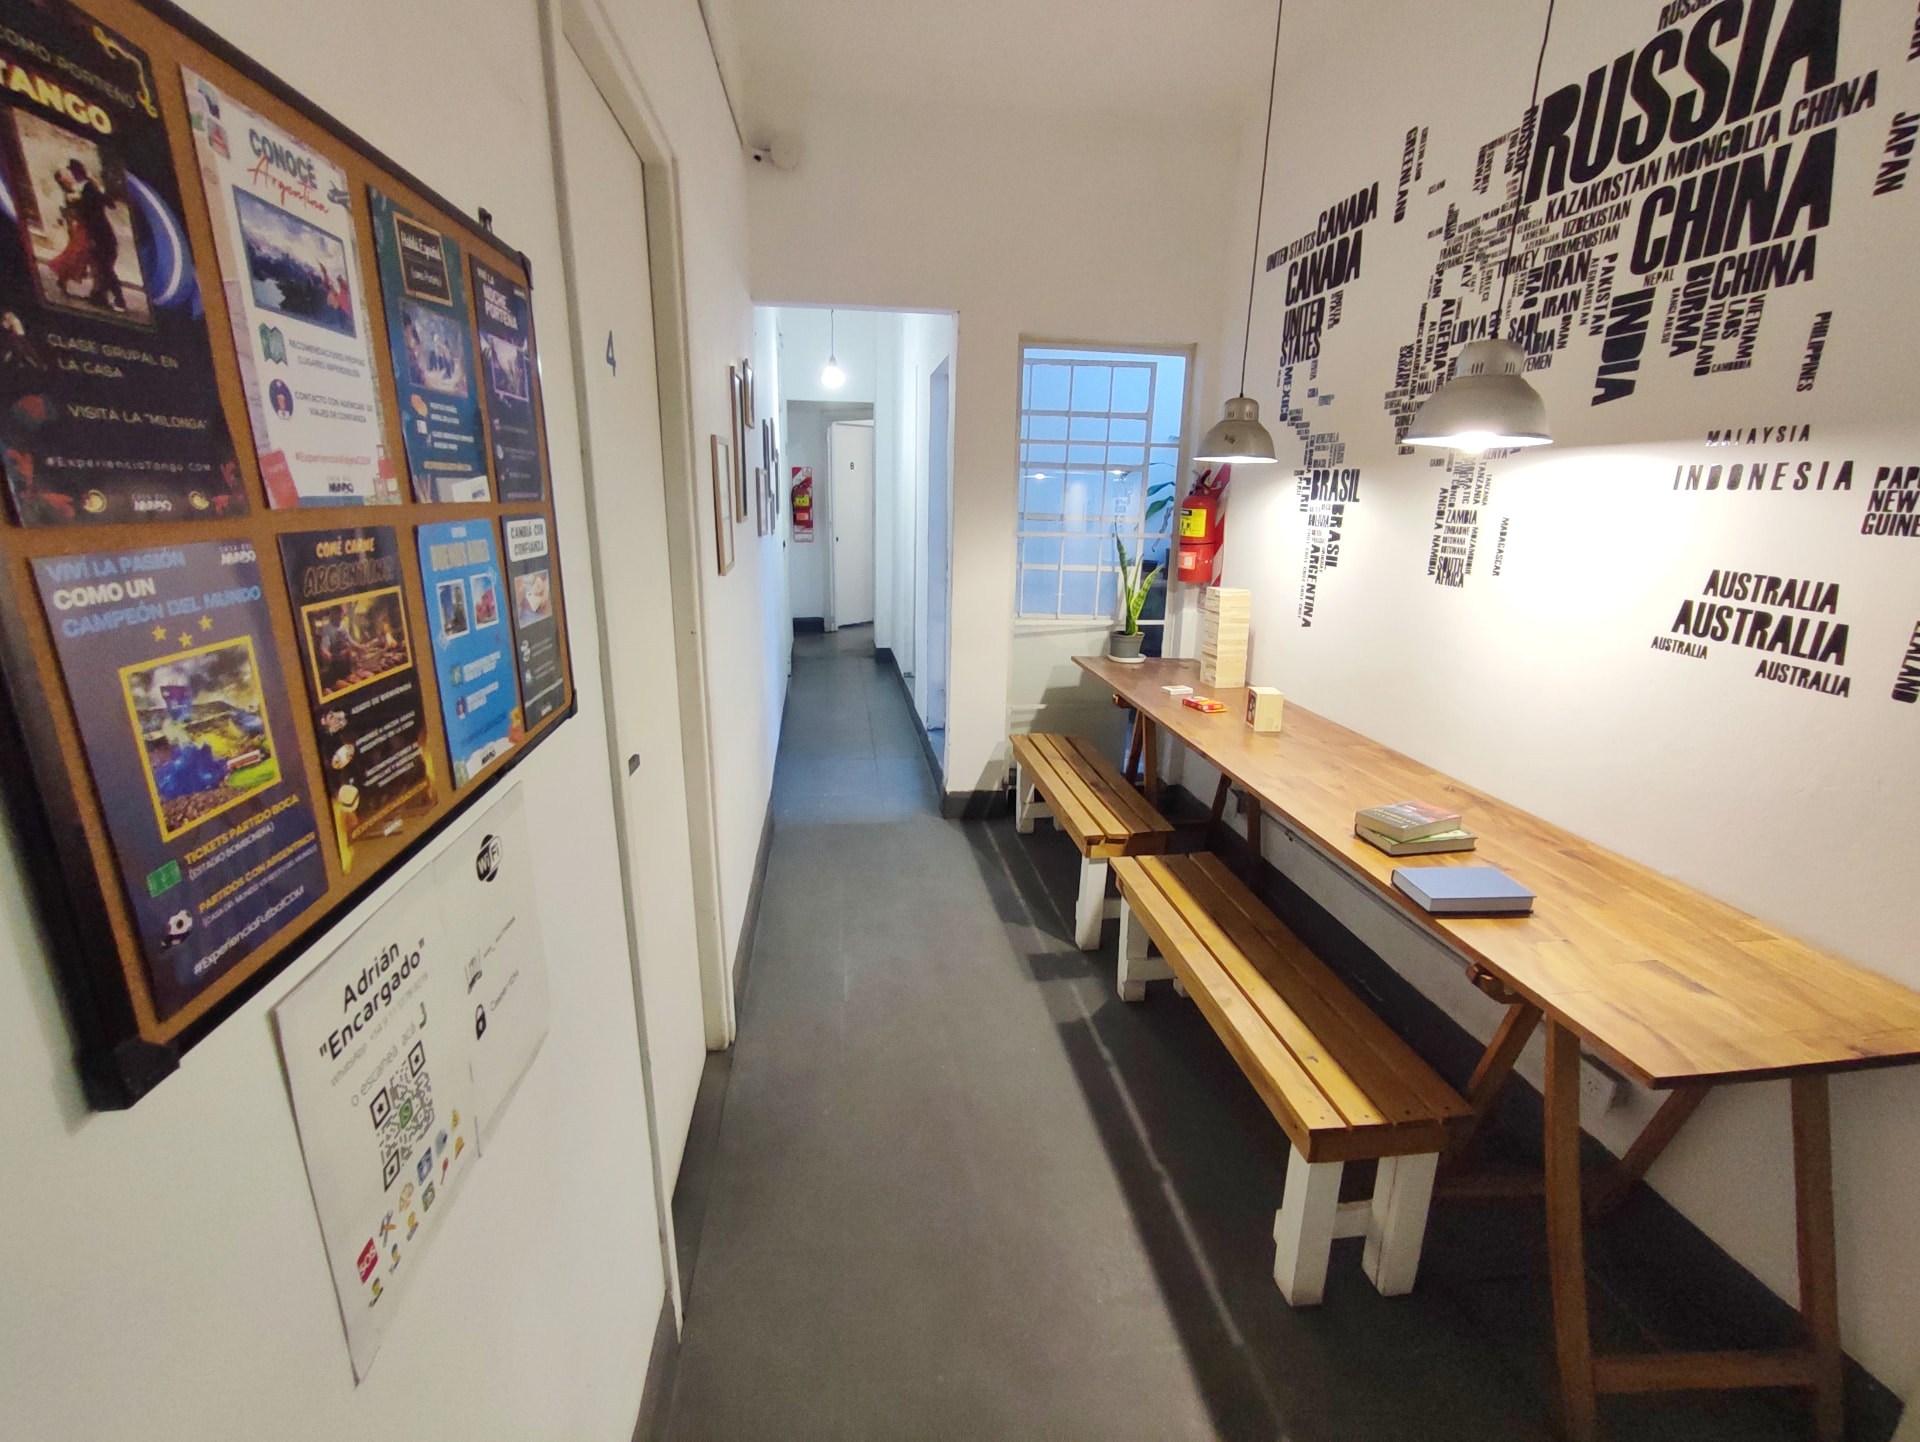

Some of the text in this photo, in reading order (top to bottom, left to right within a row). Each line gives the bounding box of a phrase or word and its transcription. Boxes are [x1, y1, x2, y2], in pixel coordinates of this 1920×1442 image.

[0, 25, 51, 62] OMO
[1523, 0, 1842, 206] RUSSIA
[1787, 69, 1879, 137] CHINA
[1663, 109, 1782, 184] MONGOLIA
[1394, 126, 1419, 224] GREENLAND
[1545, 155, 1663, 226] KAZAKHSTAN
[1316, 181, 1379, 248] CANADA
[1561, 198, 1633, 239] UZBEKISTAN
[1630, 127, 1838, 276] CHINA
[1288, 231, 1317, 262] STATES
[1496, 247, 1541, 280] TURKEY
[1543, 223, 1621, 263] TURKMENISTAN
[1285, 229, 1364, 307] CANADA
[1541, 248, 1593, 294] IRAN
[1643, 269, 1675, 288] NEPAL
[1711, 234, 1818, 301] CHINA
[1542, 289, 1582, 320] IRAN
[1578, 257, 1601, 327] AFGHANISTAN
[1588, 251, 1619, 337] PAKISTAN
[1668, 260, 1716, 359] BURMA
[1279, 328, 1322, 368] STATES
[1423, 320, 1438, 365] ALGERIA
[1432, 298, 1457, 373] ALGERIA
[1556, 313, 1574, 350] OMAN
[1591, 287, 1656, 408] INDIA
[1693, 300, 1726, 377] THAILAND
[1736, 293, 1767, 361] VIETNAM
[57, 358, 80, 371] LA
[605, 330, 617, 377] 4
[1796, 310, 1833, 393] PHILIPPINES
[66, 403, 120, 421] VISITA
[1279, 366, 1295, 422] MEXICO
[1706, 423, 1811, 447] MALAYSIA
[1310, 468, 1361, 503] BRASIL
[1472, 461, 1487, 505] TANZANIA
[1673, 460, 1854, 491] INDONESIA
[1873, 465, 1920, 490] PAP
[1433, 487, 1449, 531] ANGOLA
[1445, 509, 1478, 526] ZAMBIA
[1866, 490, 1918, 514] NEW
[1324, 503, 1345, 569] BRASIL
[1427, 534, 1442, 577] NAMIBIA
[1491, 517, 1510, 577] MADAGASCAR
[91, 558, 118, 577] LA
[118, 547, 188, 575] PASIÓN
[53, 576, 157, 611] COMO UN
[1301, 543, 1322, 628] ARGENTINA
[1702, 569, 1840, 615] AUSTRALIA
[61, 585, 262, 639] CAMPEÓN DEL MUNDO
[1671, 599, 1850, 666] AUSTRALIA
[1650, 635, 1709, 660] AUSTRALIA
[1755, 659, 1851, 699] AUSTRALIA
[184, 793, 300, 865] TICKETS PARTIDO BOCA
[342, 942, 400, 1014] Adrián
